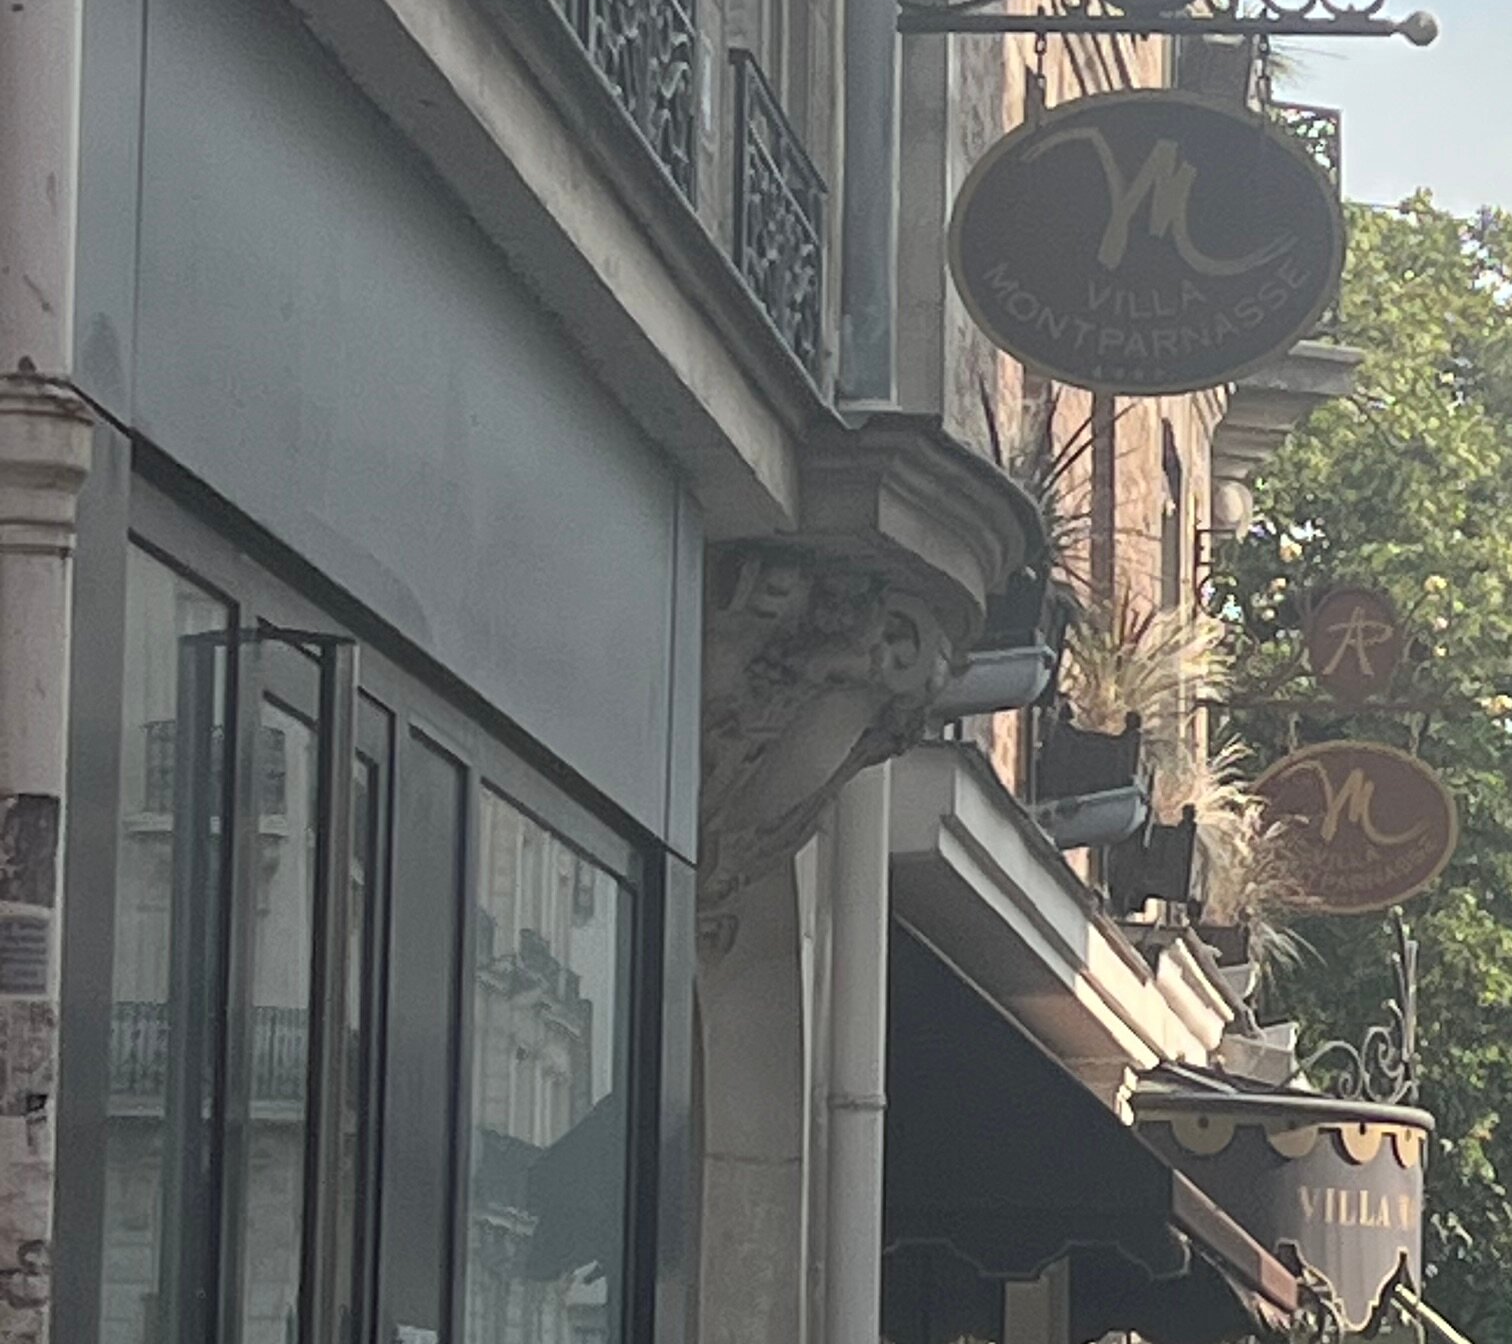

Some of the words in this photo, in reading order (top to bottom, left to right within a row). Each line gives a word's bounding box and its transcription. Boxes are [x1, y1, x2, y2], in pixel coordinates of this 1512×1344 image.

[983, 257, 1311, 359] MONTPARNASSE
[1087, 279, 1206, 320] VILLA
[1298, 1186, 1391, 1228] VILLA
